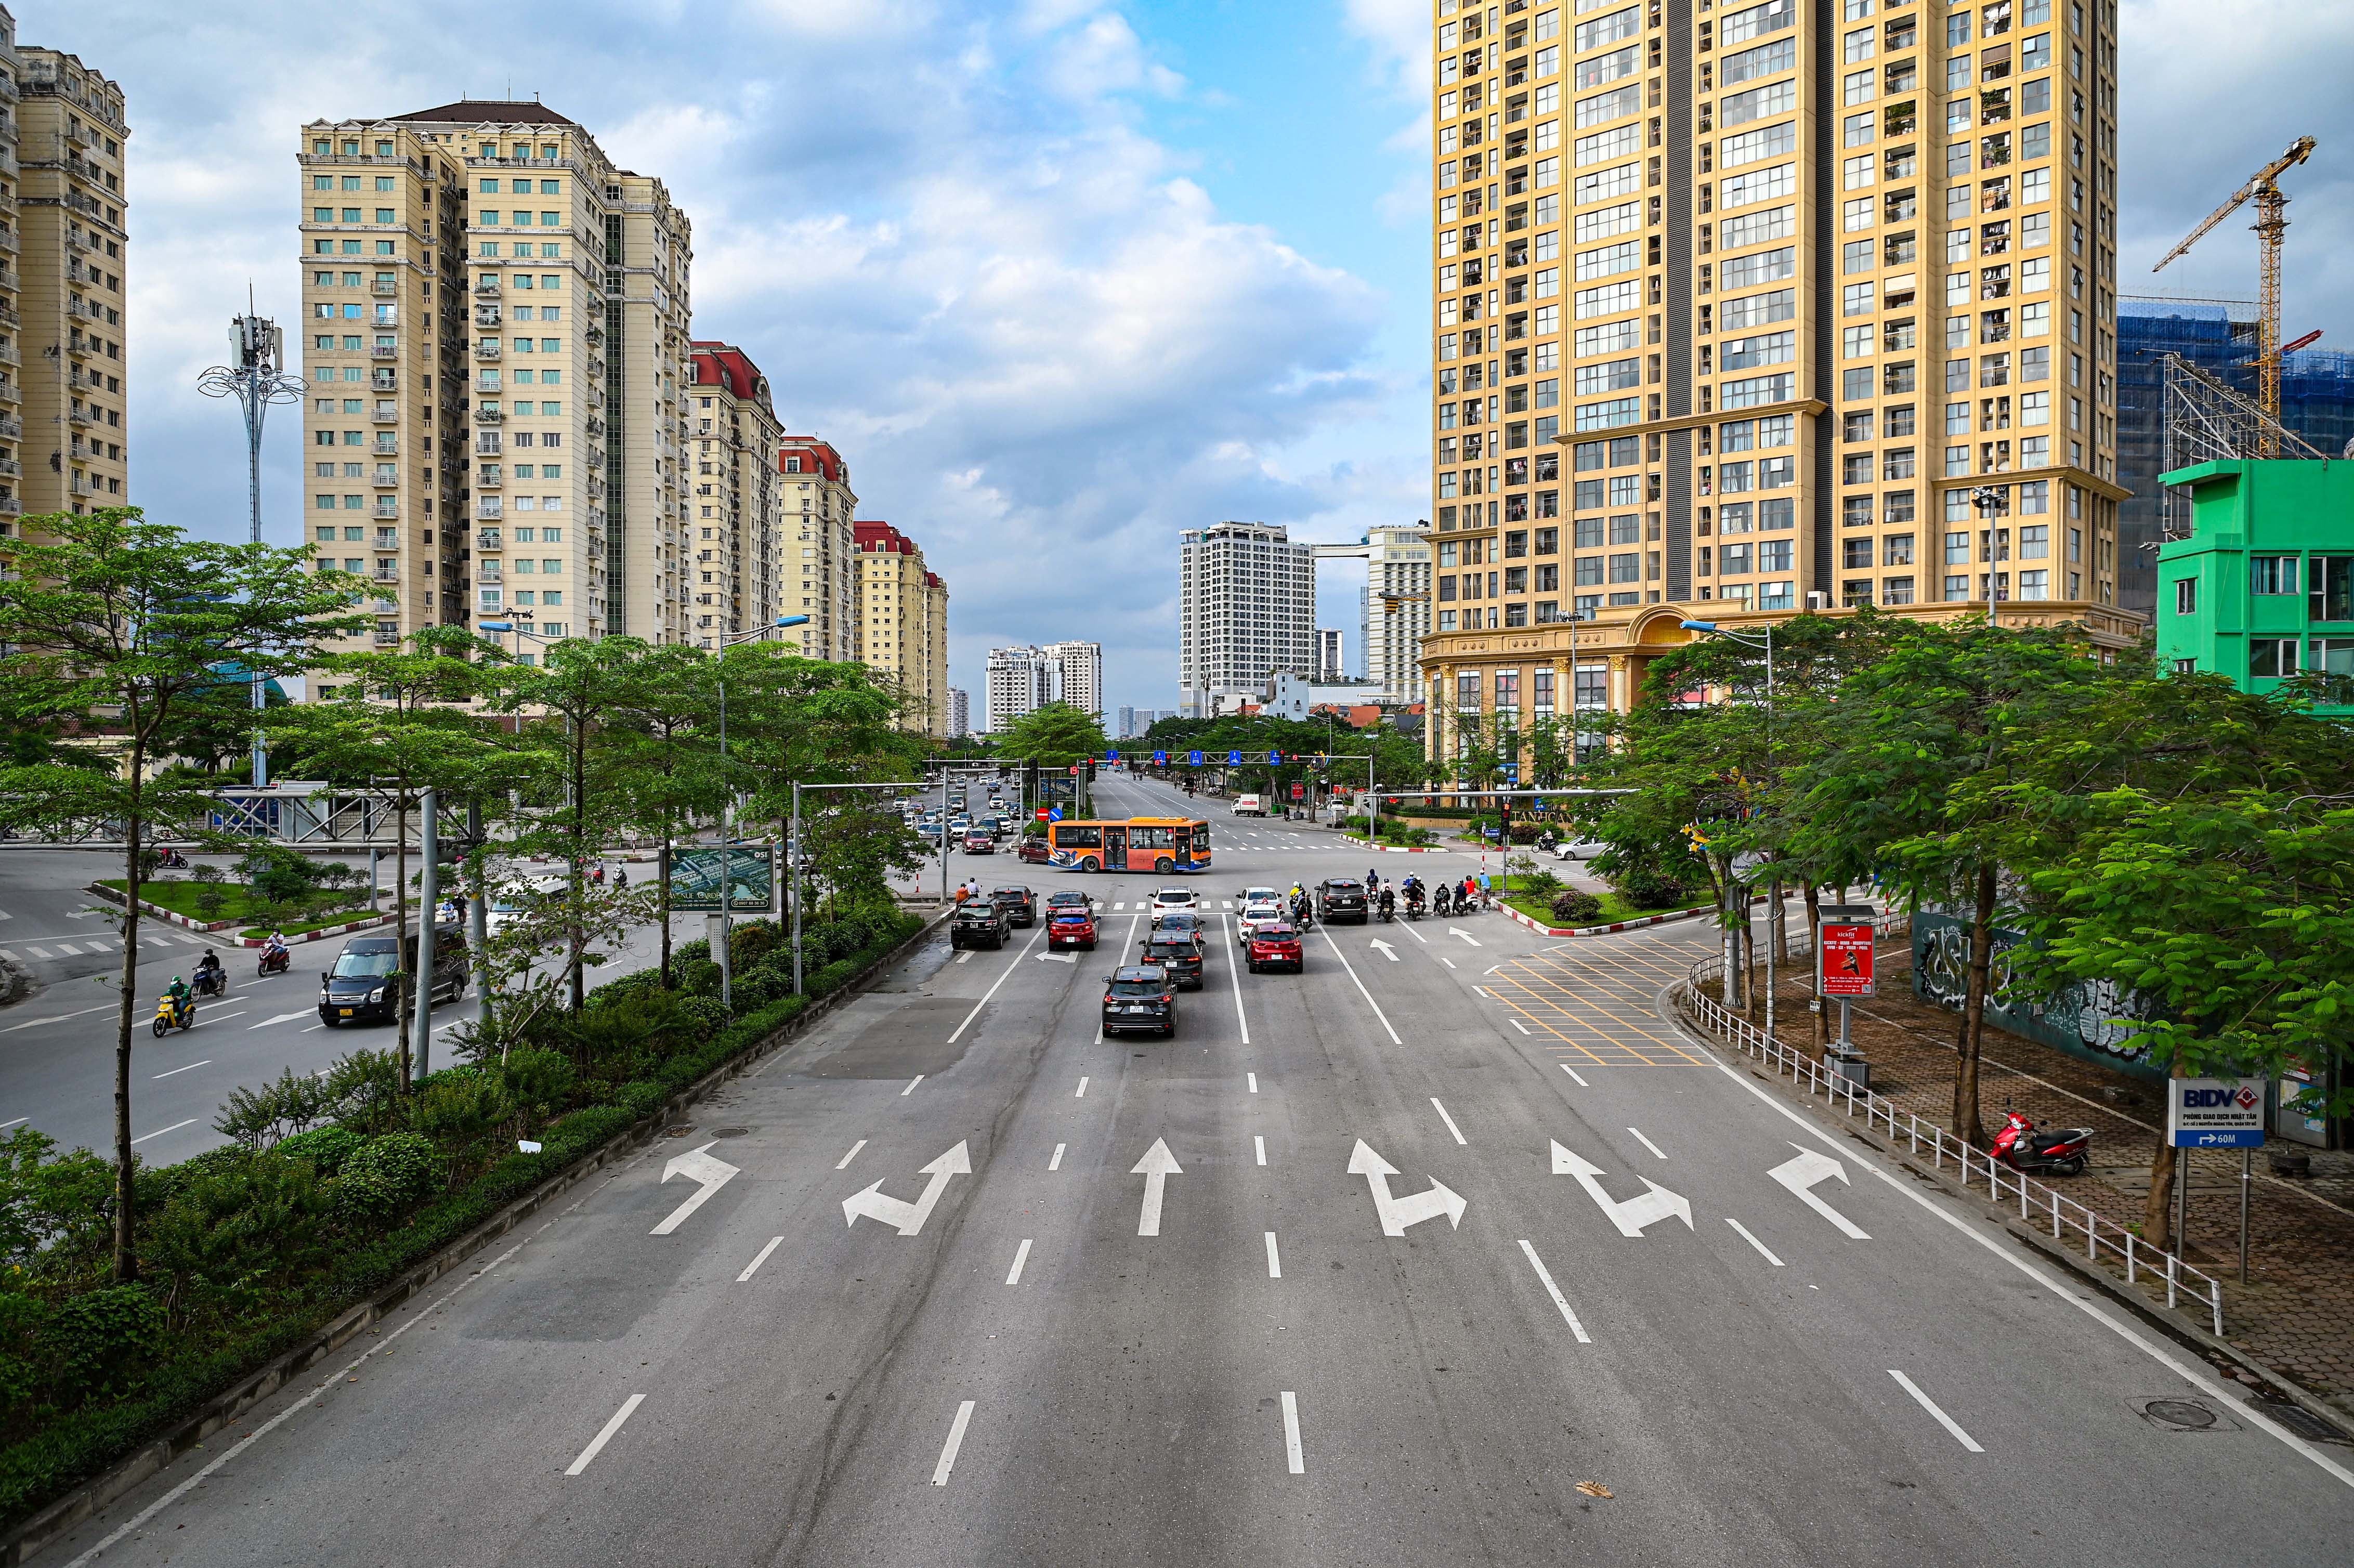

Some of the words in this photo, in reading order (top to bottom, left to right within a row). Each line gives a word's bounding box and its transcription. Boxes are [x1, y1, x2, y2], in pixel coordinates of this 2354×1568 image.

[1070, 766, 1077, 775] 19
[2184, 1089, 2237, 1107] BIDV
[2218, 1134, 2235, 1143] 60M
